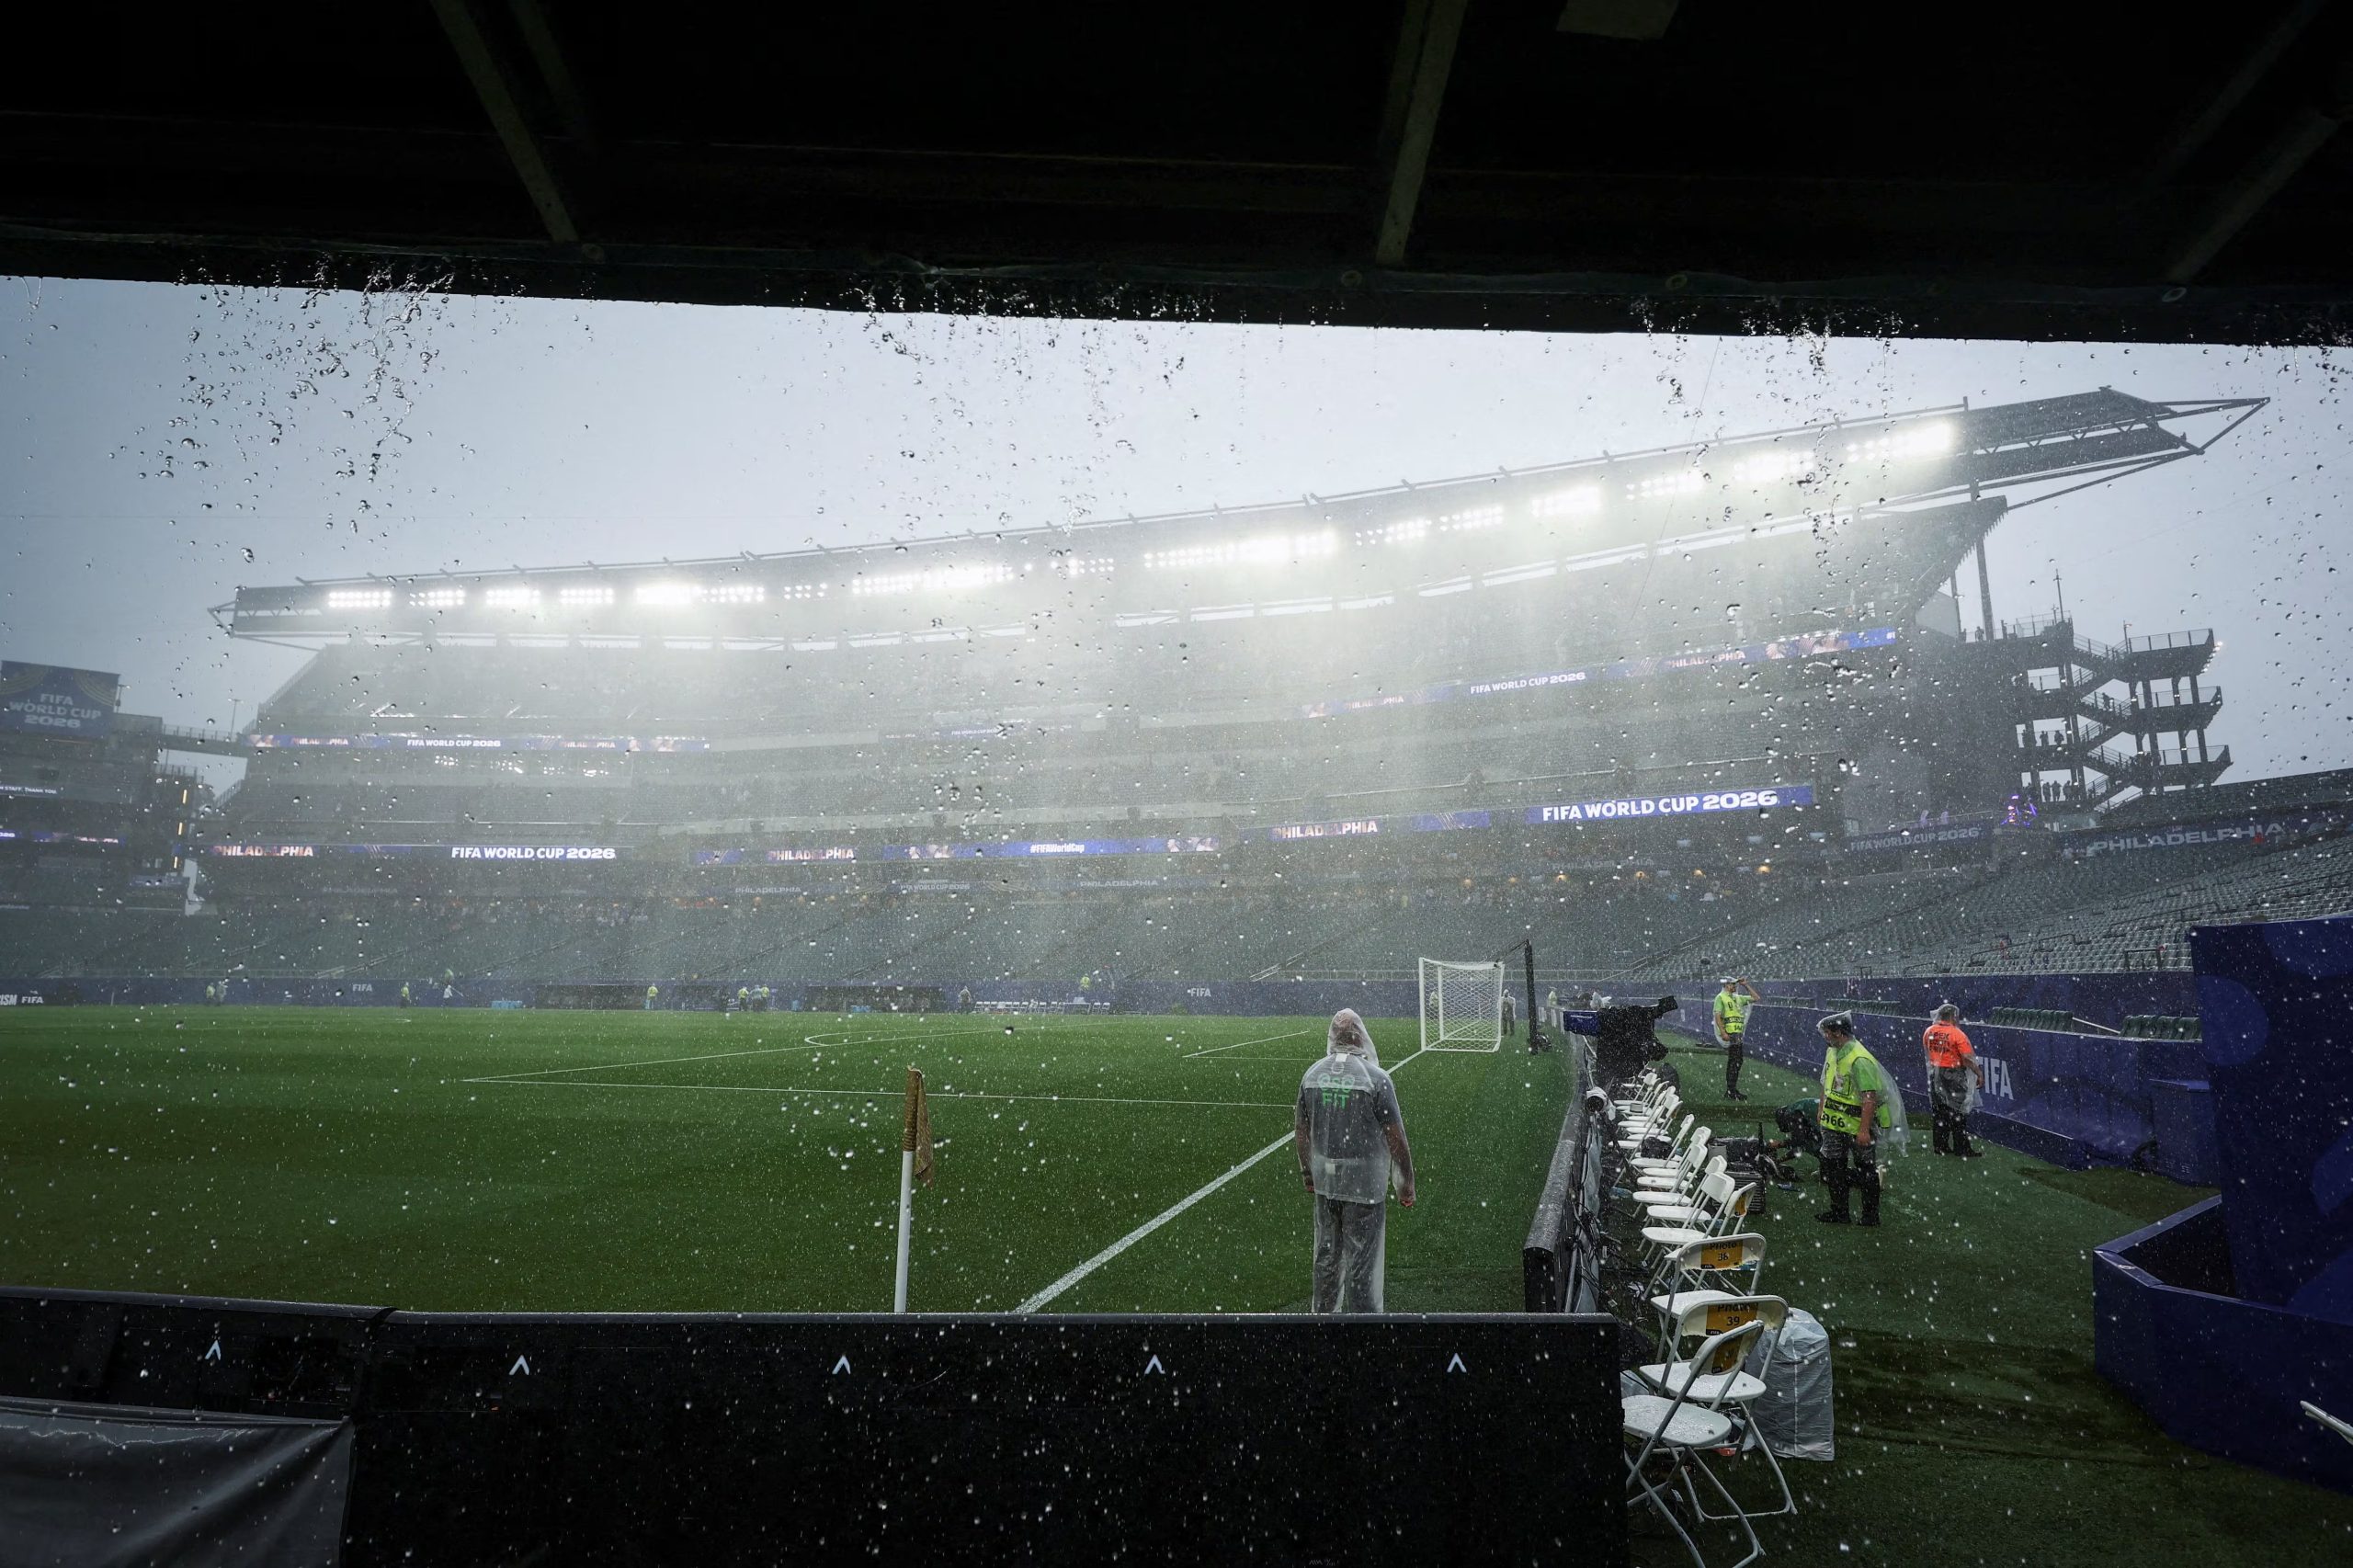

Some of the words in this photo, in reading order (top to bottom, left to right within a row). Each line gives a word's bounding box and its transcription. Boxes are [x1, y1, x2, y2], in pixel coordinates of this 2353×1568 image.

[1471, 684, 1491, 695] FIFA
[1492, 679, 1527, 691] WORLD
[1529, 676, 1549, 687] CUP
[1550, 671, 1586, 684] 2026
[40, 693, 74, 706] FIFA
[9, 701, 68, 715] WORLD
[71, 708, 102, 720] CUP
[24, 714, 82, 728] 2026
[426, 739, 455, 747] WORLD
[456, 739, 472, 747] CUP
[1542, 804, 1582, 822] FIFA
[1584, 800, 1654, 818] WORLD
[1658, 795, 1699, 813] CUP
[1702, 790, 1779, 811] 2026
[1850, 839, 1873, 851] FIFA
[1873, 835, 1912, 849] WORLD
[1913, 833, 1937, 843] CUP
[1938, 826, 1980, 841] 2026
[2093, 823, 2285, 852] PHILADELPHIA
[451, 846, 482, 858] FIFA
[483, 846, 534, 858] WORLD
[536, 847, 565, 859] CUP
[566, 846, 616, 859] 2026
[1029, 842, 1086, 854] #FIFAWorldCup
[915, 883, 936, 892] WORLD
[936, 883, 949, 892] CUP
[1080, 879, 1159, 888] PHILADELPHIA
[735, 886, 802, 894] PHILADELPHIA
[352, 983, 373, 993] FIFA
[1190, 987, 1212, 997] FIFA
[0, 994, 17, 1006] ISM
[1322, 1092, 1350, 1109] FIT
[1727, 1315, 1740, 1326] 39
